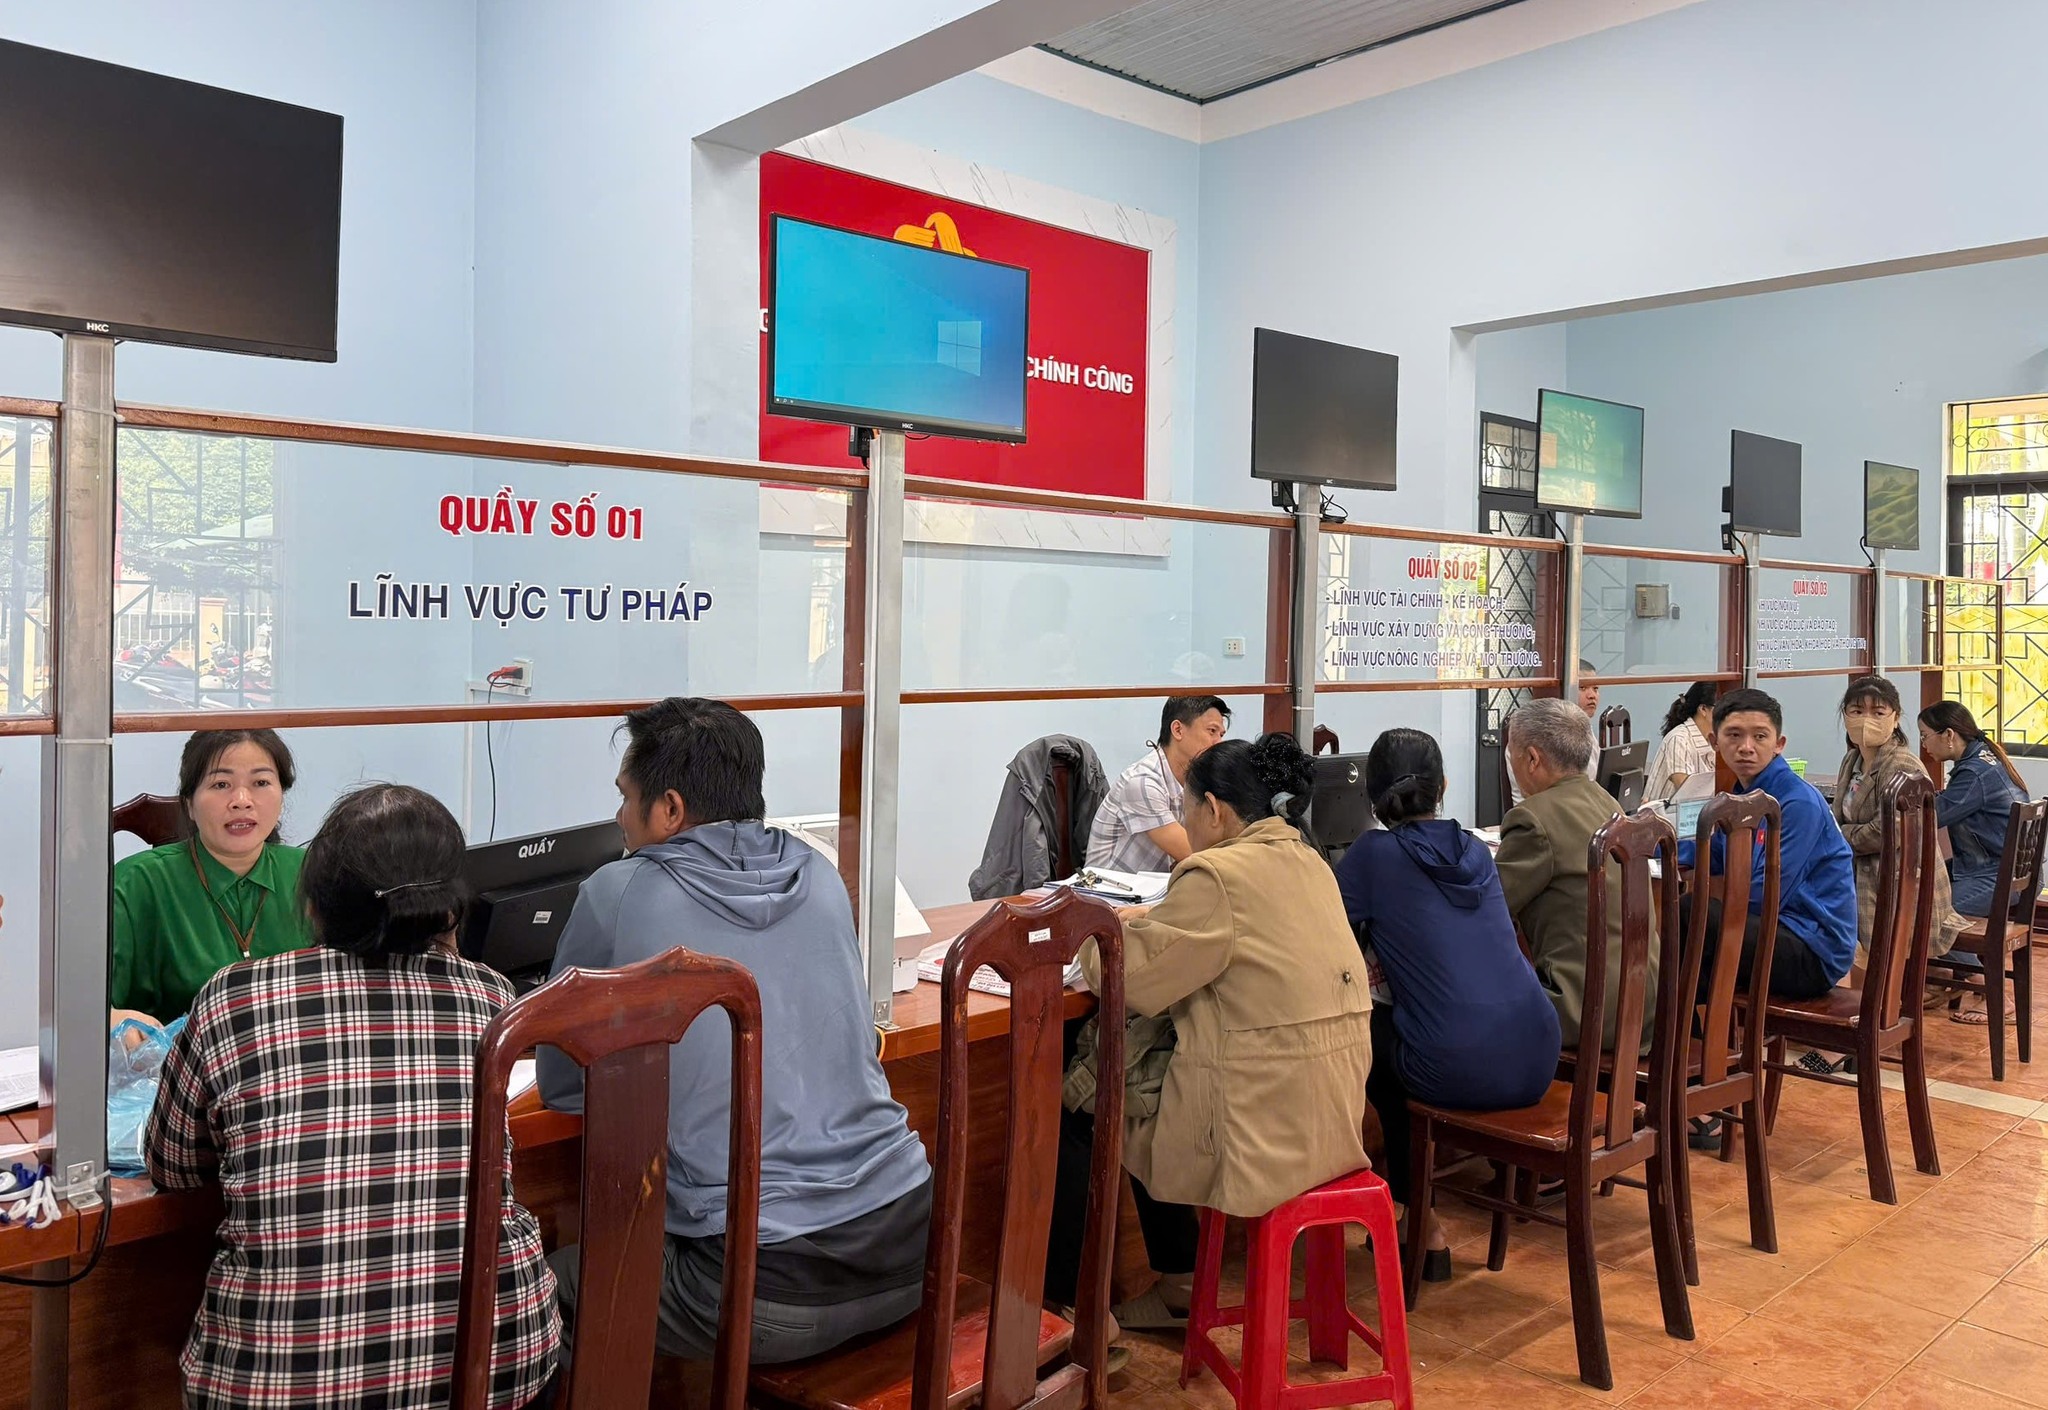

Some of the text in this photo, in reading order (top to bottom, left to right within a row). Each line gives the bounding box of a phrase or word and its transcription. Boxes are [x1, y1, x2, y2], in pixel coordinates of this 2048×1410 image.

[86, 322, 109, 333] HKC
[1084, 364, 1134, 394] CÔNG
[439, 486, 643, 540] QUẦY SỐ 01
[1408, 551, 1477, 581] QUẦY SỐ 02
[349, 572, 714, 628] LĨNH VỰC TƯ PHÁP
[1333, 586, 1360, 606] LĨNH
[1364, 589, 1387, 610] VỰC
[1390, 588, 1407, 608] TÀI
[1410, 589, 1443, 609] CHÍNH
[1452, 588, 1466, 609] KẾ
[1331, 617, 1359, 637] LĨNH
[1362, 619, 1386, 640] VỰC
[1388, 618, 1411, 638] XÂY
[1414, 621, 1444, 641] DỰNG
[1446, 620, 1460, 639] VÀ
[1331, 647, 1359, 667] LĨNH
[1362, 649, 1386, 670] VỰC
[1387, 648, 1418, 667] NÔNG
[1422, 648, 1462, 670] NGHIỆP
[518, 836, 556, 859] QUẦY
